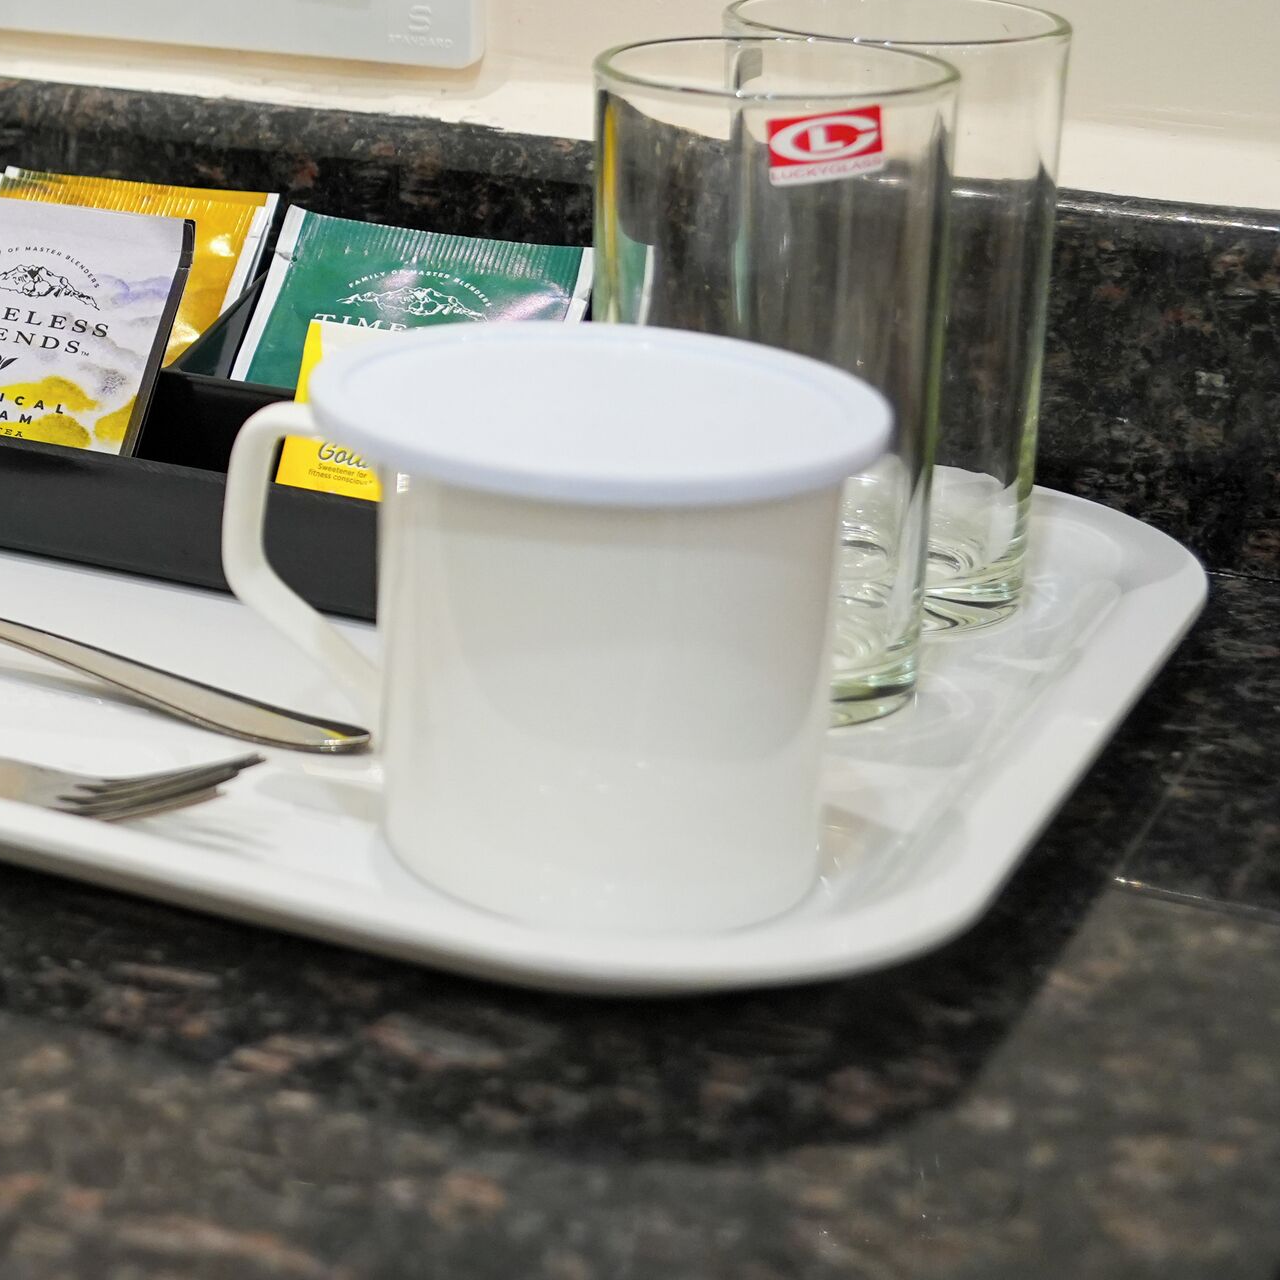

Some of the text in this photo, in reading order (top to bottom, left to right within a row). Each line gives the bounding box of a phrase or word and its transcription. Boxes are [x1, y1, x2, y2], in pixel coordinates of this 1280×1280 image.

[25, 246, 62, 257] MASTER
[65, 255, 100, 289] BLENDERS
[349, 272, 386, 288] FAMILY
[453, 277, 492, 308] BLENDERS
[308, 468, 331, 480] fitness
[318, 463, 367, 479] Sweetener for
